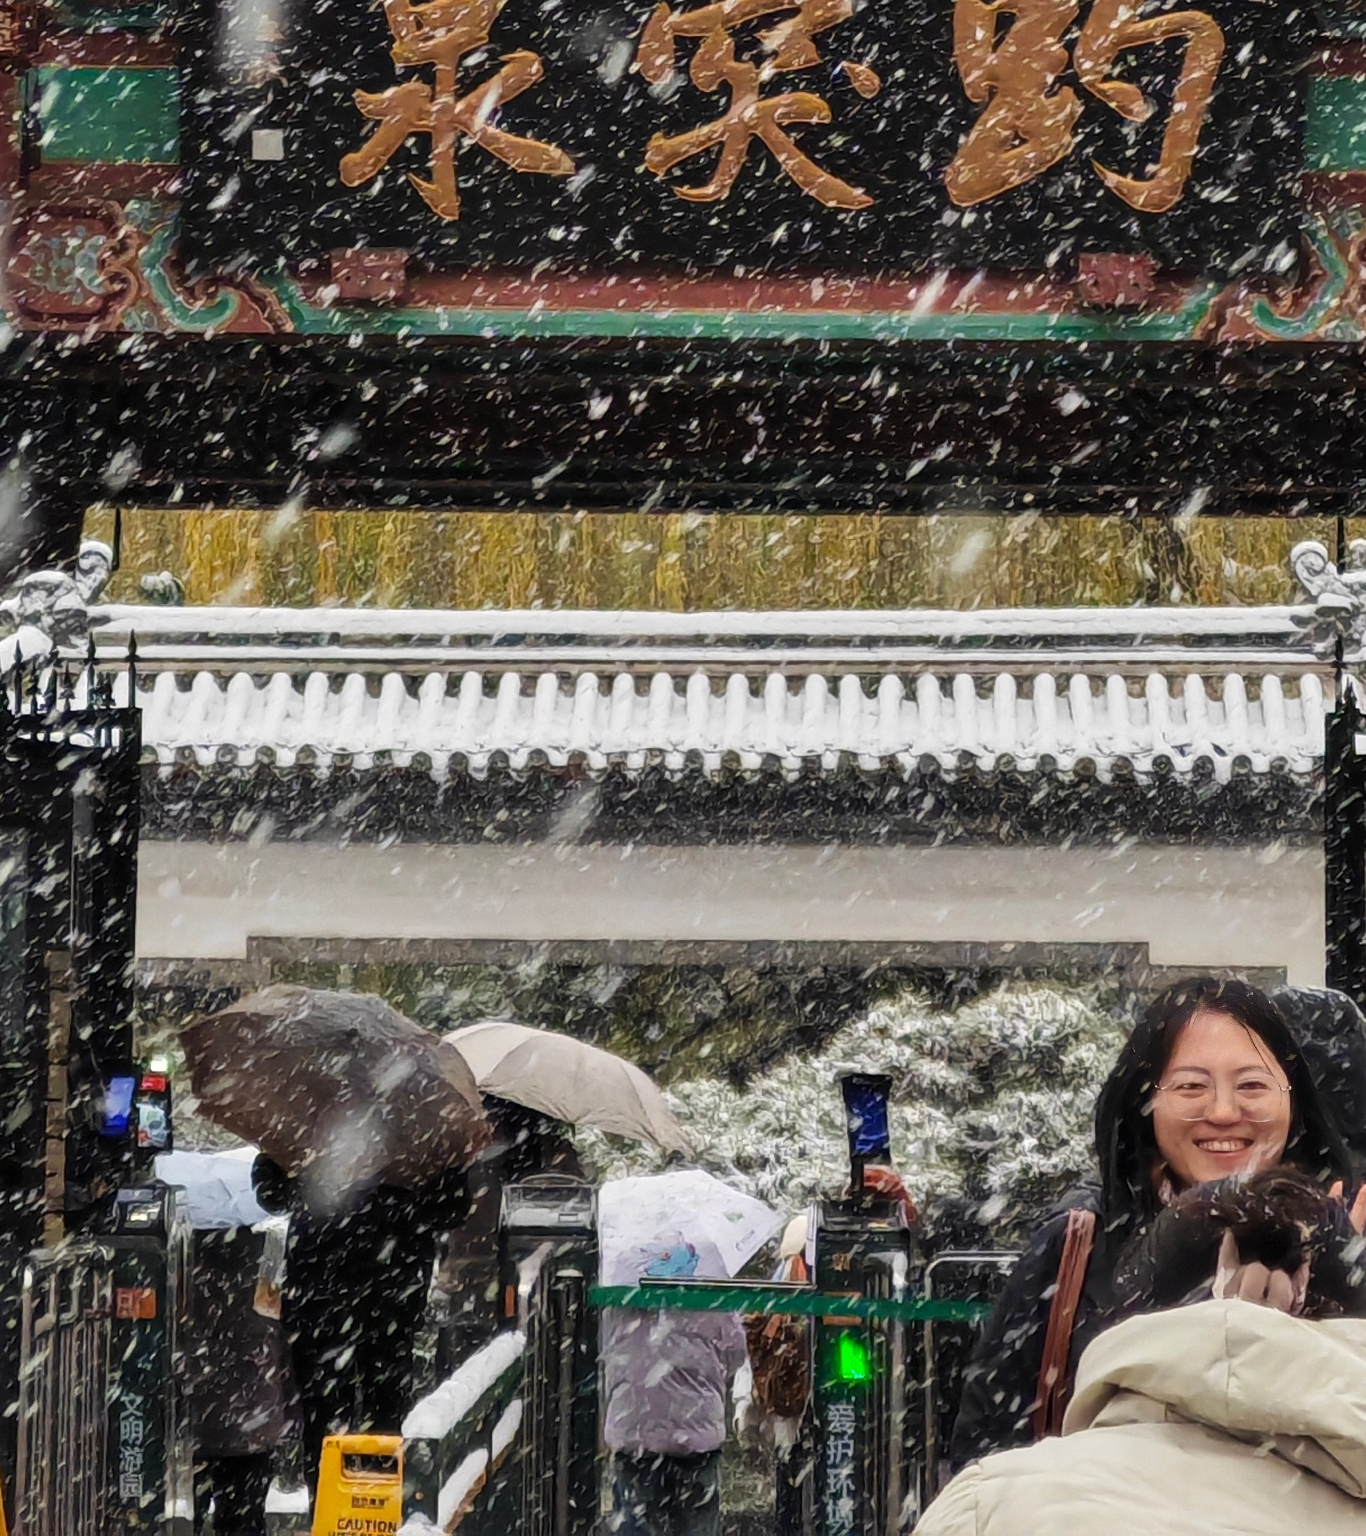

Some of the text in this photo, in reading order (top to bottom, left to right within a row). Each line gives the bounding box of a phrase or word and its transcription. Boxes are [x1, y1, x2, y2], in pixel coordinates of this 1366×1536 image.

[119, 1393, 144, 1498] 文明游园
[336, 1517, 397, 1533] CAUTION
